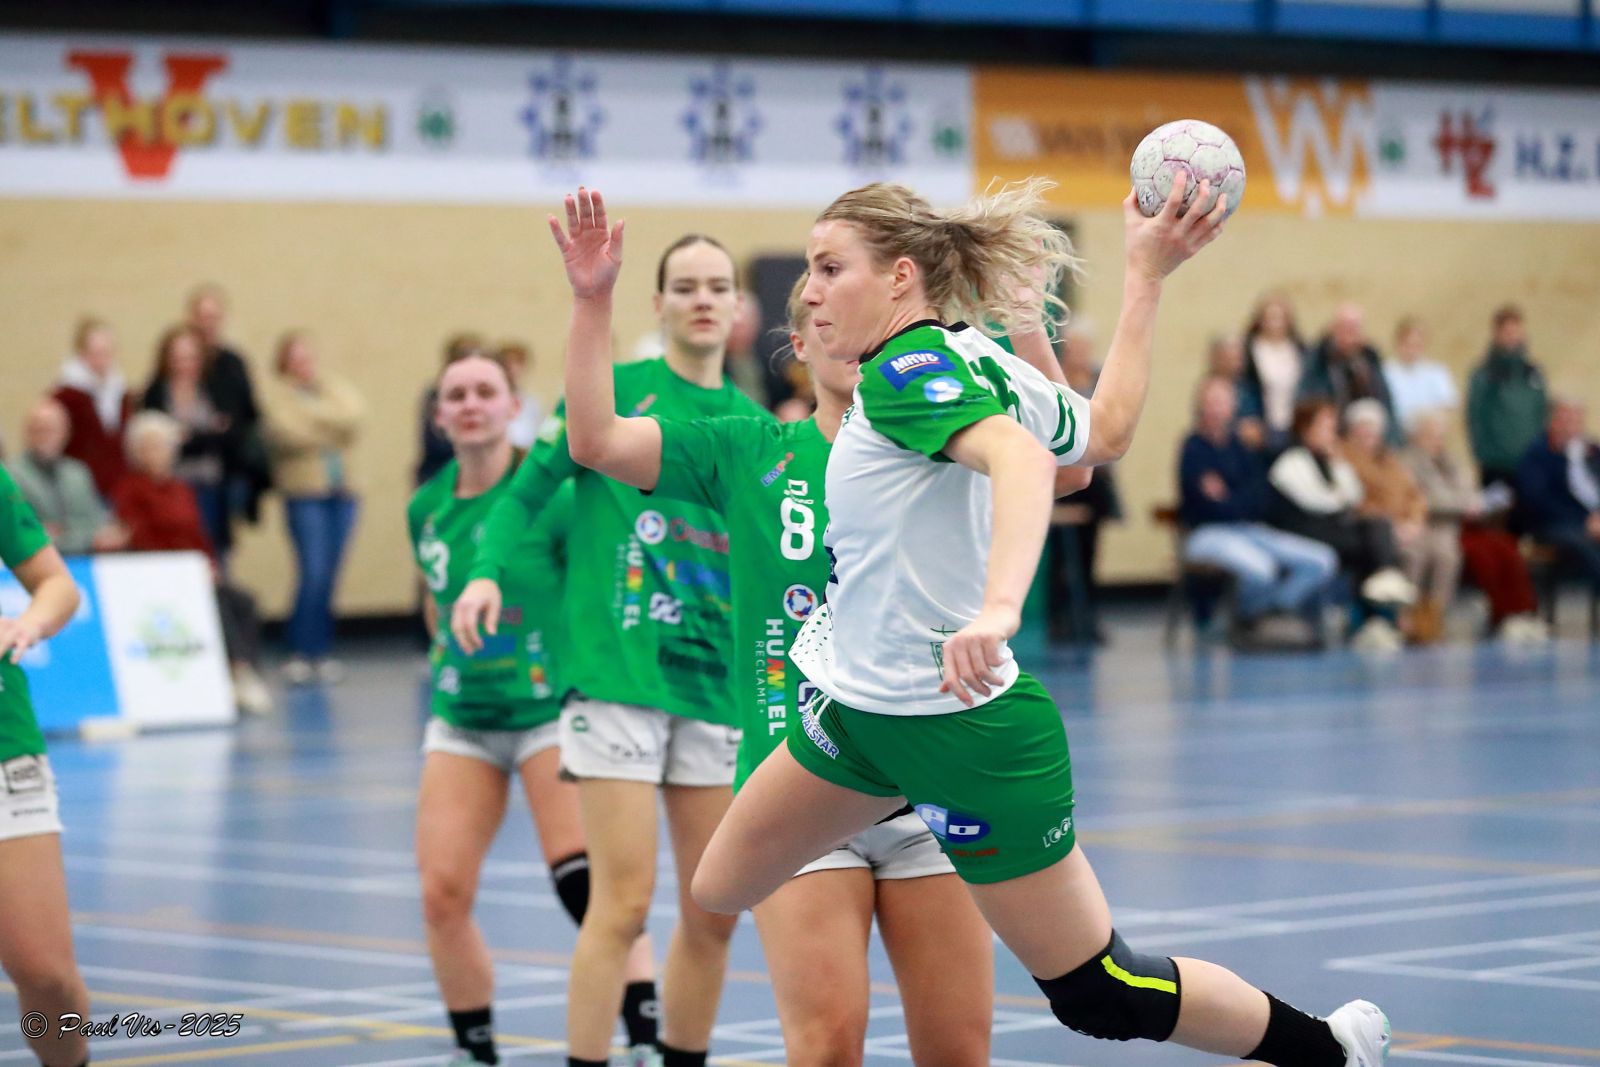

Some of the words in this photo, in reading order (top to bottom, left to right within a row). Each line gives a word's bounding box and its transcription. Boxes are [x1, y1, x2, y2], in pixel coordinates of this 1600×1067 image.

[0, 94, 391, 151] LTHOVEN
[780, 497, 815, 561] 8
[754, 640, 768, 706] RECLAME
[765, 618, 787, 736] HUMMEL
